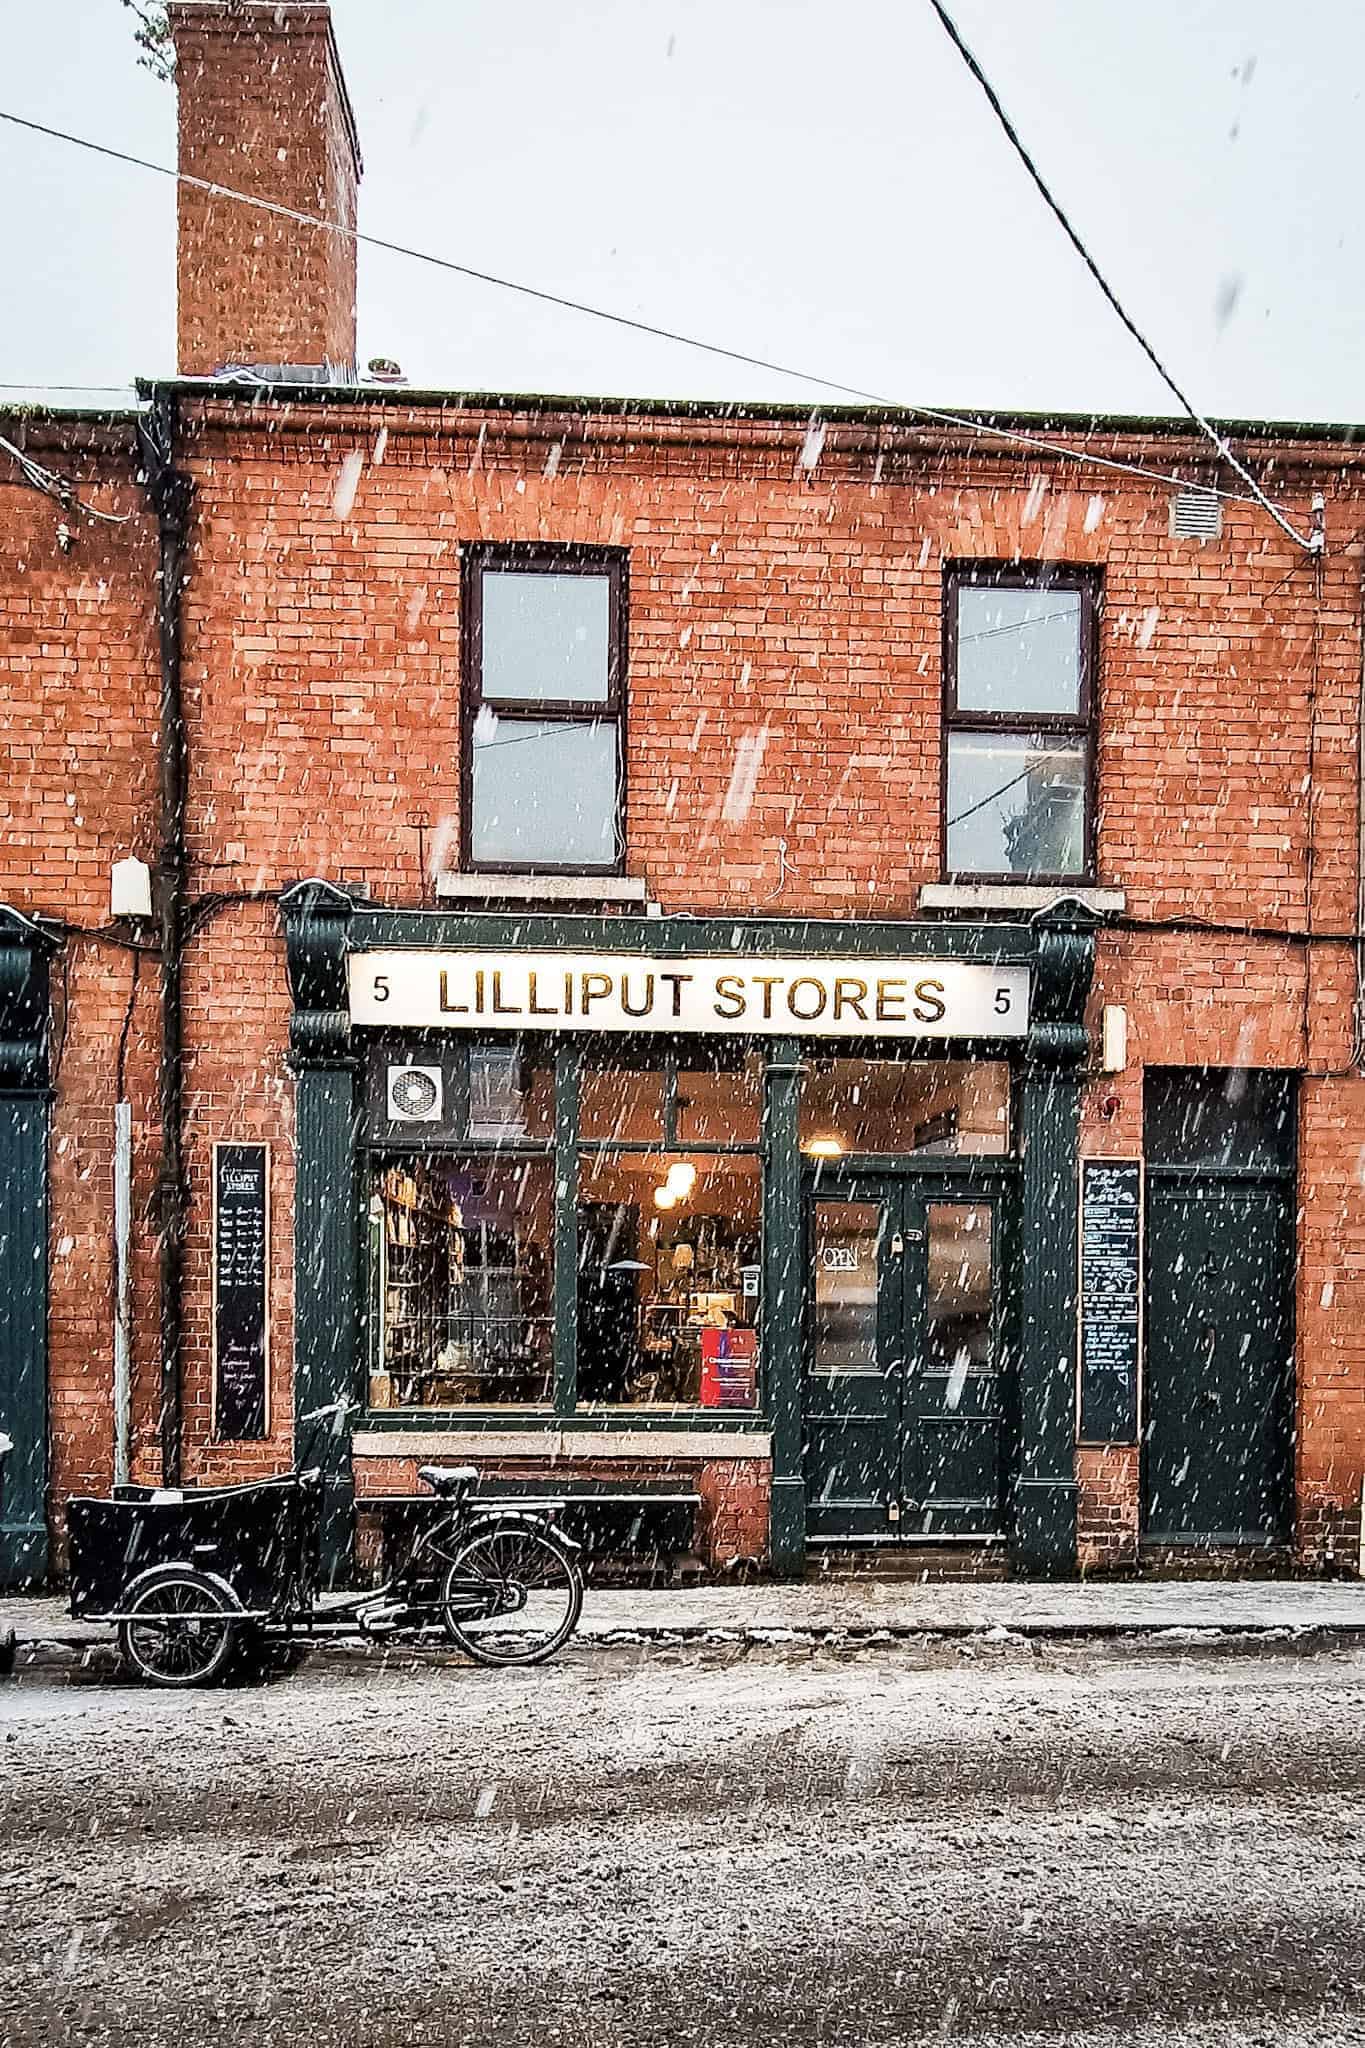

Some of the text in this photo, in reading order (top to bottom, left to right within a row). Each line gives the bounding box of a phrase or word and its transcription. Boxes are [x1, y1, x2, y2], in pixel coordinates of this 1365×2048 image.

[373, 976, 390, 1001] 5
[440, 970, 946, 1023] LILLIPUT STORES
[994, 988, 1011, 1014] 5
[221, 1173, 259, 1183] LILLIPUT
[226, 1182, 255, 1191] STORES
[823, 1247, 858, 1266] OPEN
